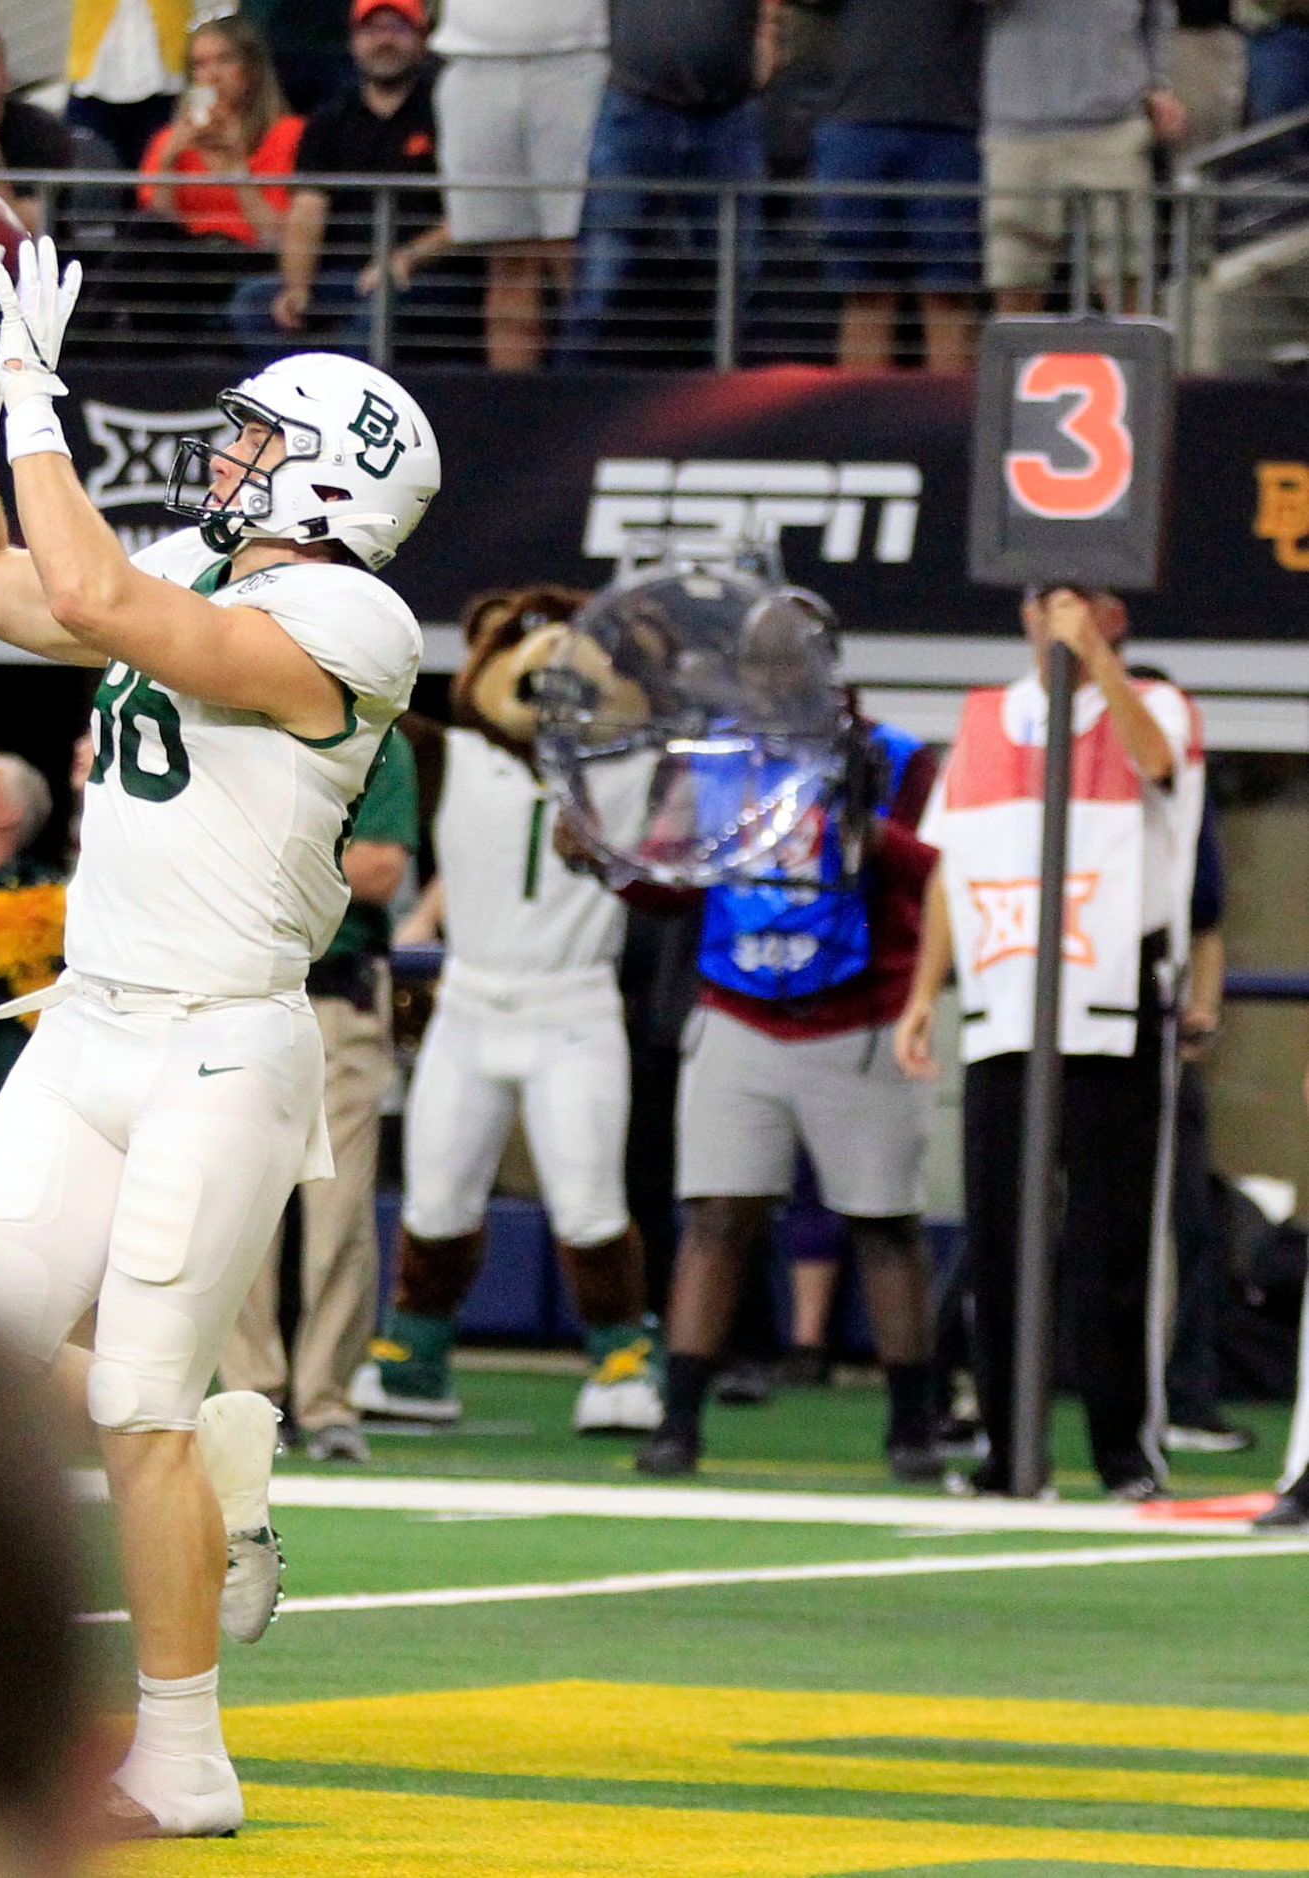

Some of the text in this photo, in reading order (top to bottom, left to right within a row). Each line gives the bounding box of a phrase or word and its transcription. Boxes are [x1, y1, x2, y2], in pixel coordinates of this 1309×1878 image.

[347, 389, 407, 480] BU
[1005, 351, 1133, 520] 3
[582, 457, 923, 564] ESPN
